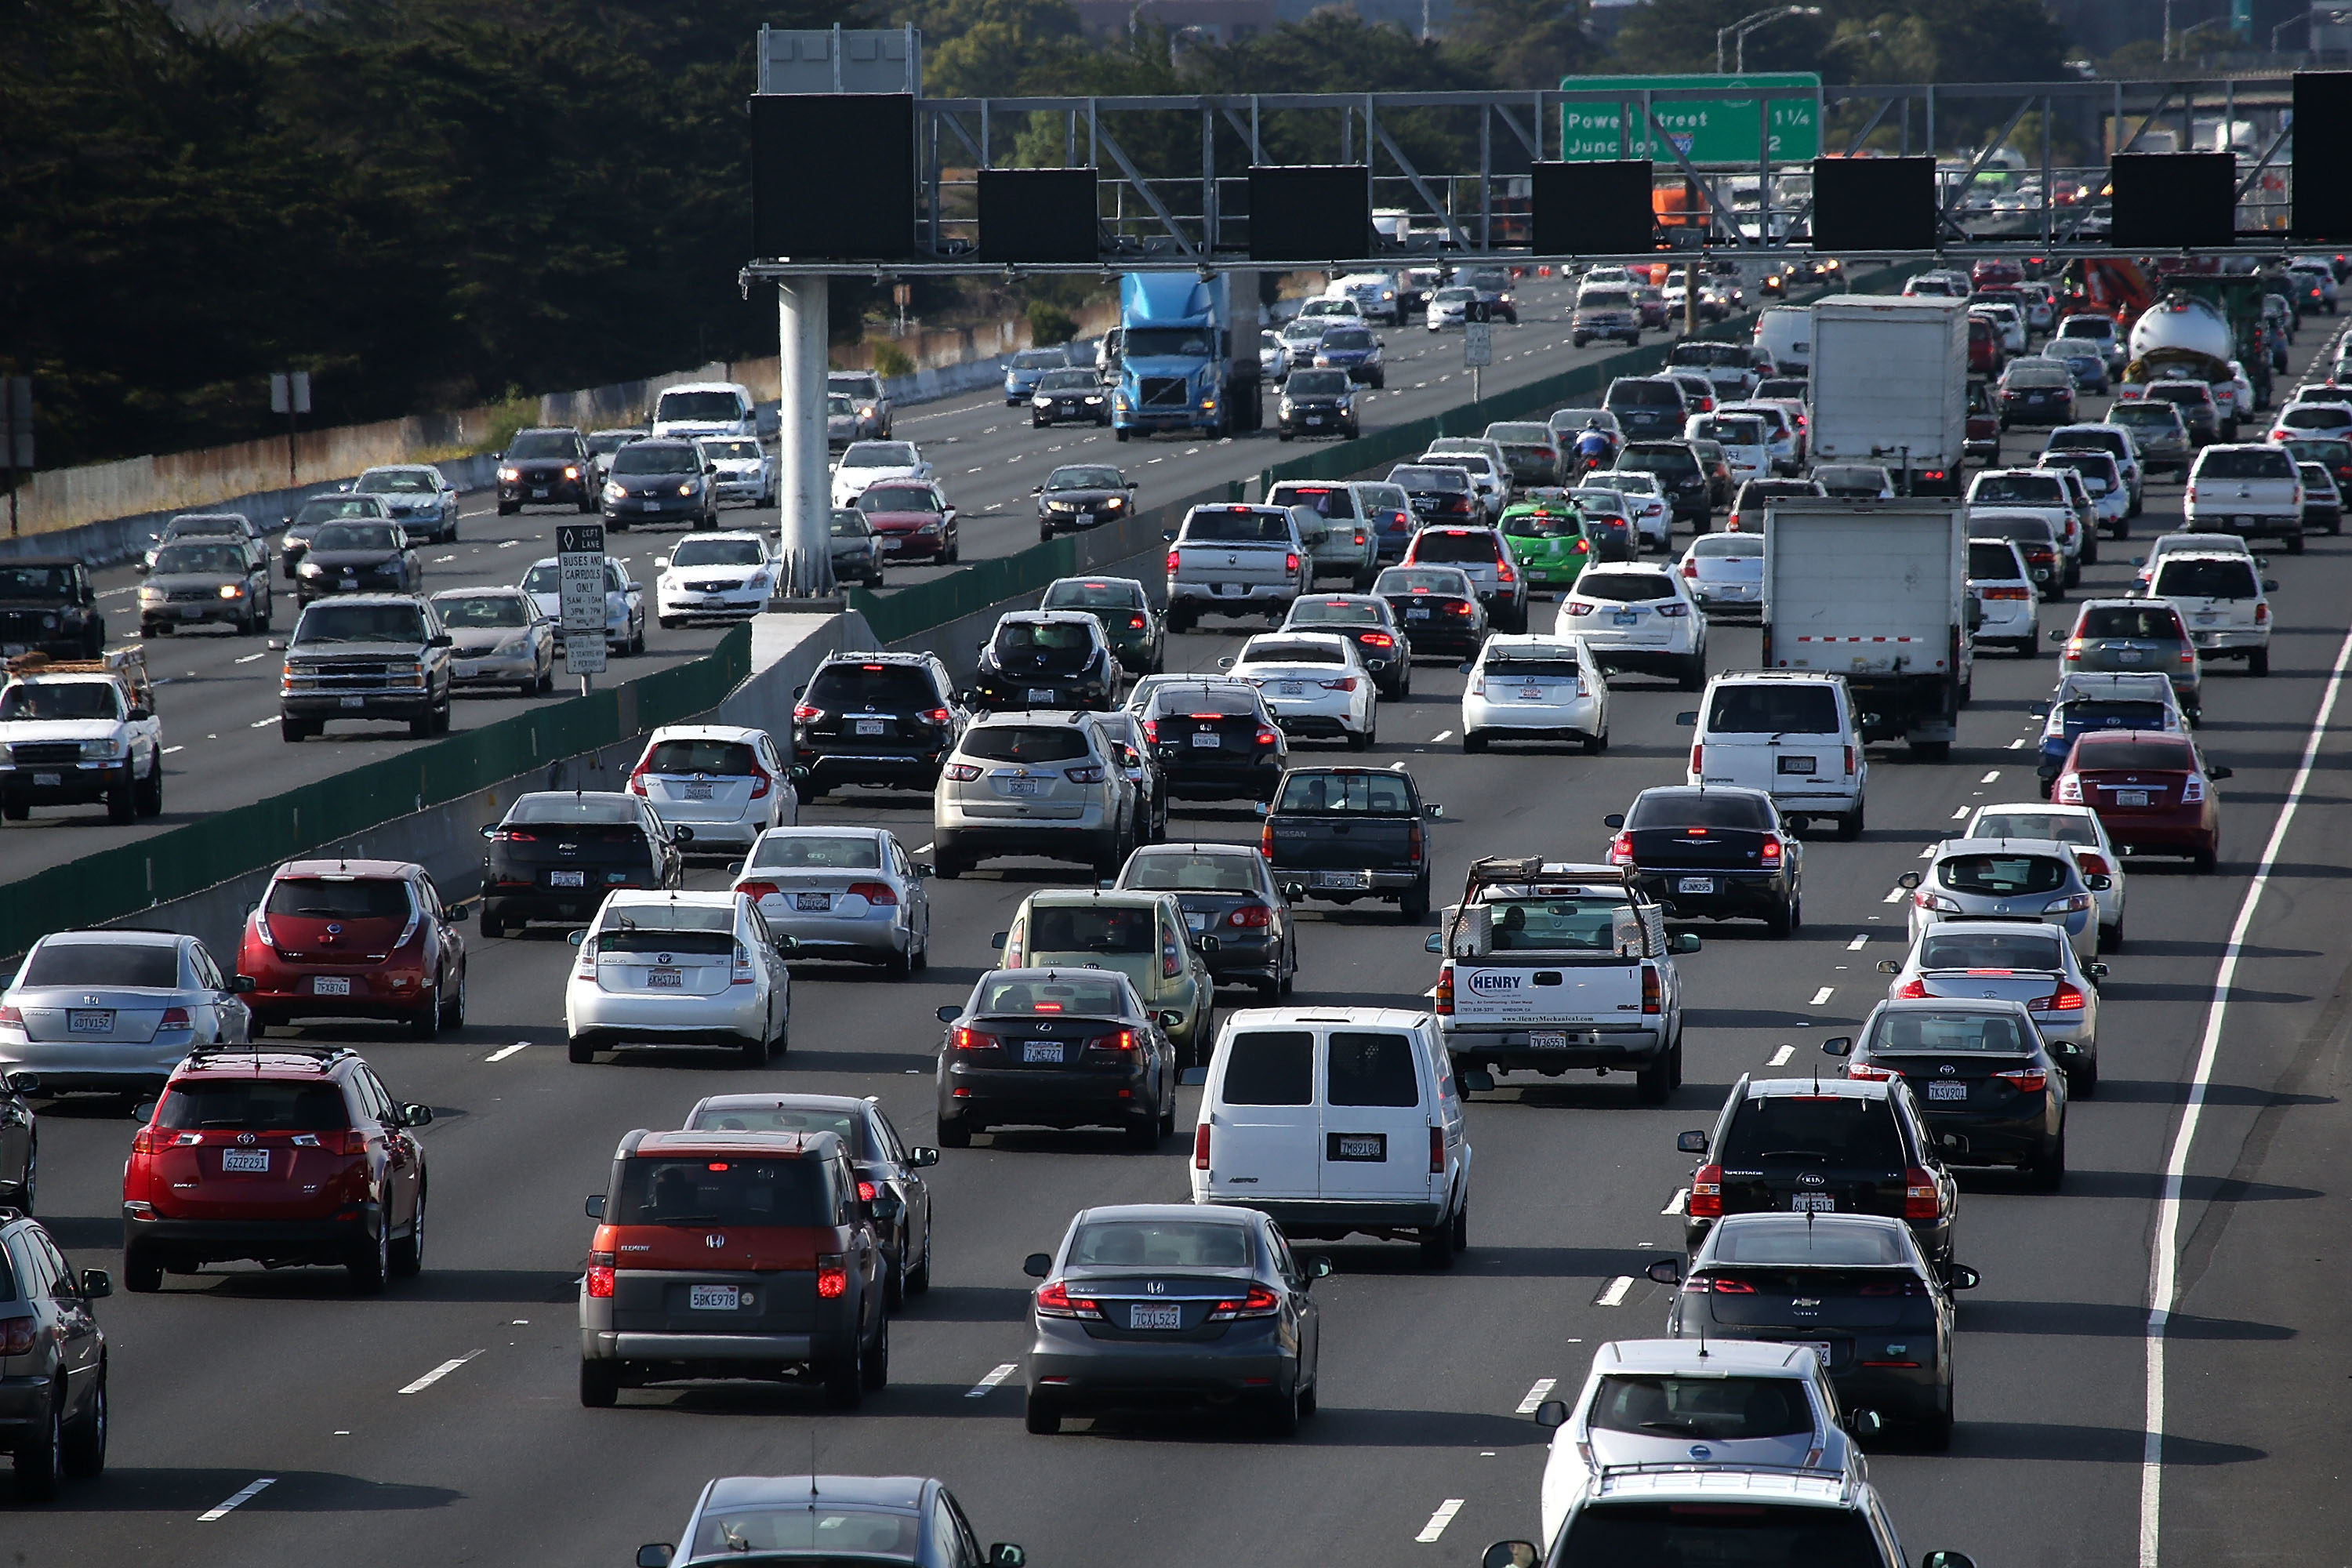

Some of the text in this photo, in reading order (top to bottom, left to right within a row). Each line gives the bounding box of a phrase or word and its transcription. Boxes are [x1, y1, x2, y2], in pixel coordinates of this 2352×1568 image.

[1569, 112, 1708, 129] Powel treet
[1569, 139, 1658, 154] Juncion
[1768, 136, 1780, 151] 2
[582, 540, 600, 549] LANE
[563, 556, 602, 566] BUSES AND
[564, 569, 601, 580] CARPOOLS
[576, 583, 594, 593] ONLY
[1628, 969, 1632, 979] 1
[317, 982, 347, 993] 7FXB761
[1474, 977, 1522, 989] HENRY
[1531, 1037, 1565, 1047] 7V36553
[1027, 1049, 1061, 1059] 7JME727
[1341, 1142, 1379, 1154] 7M89186
[227, 1156, 266, 1169] 6ZZP291
[693, 1294, 736, 1306] 5BKE978
[1134, 1312, 1177, 1326] 7CXL523
